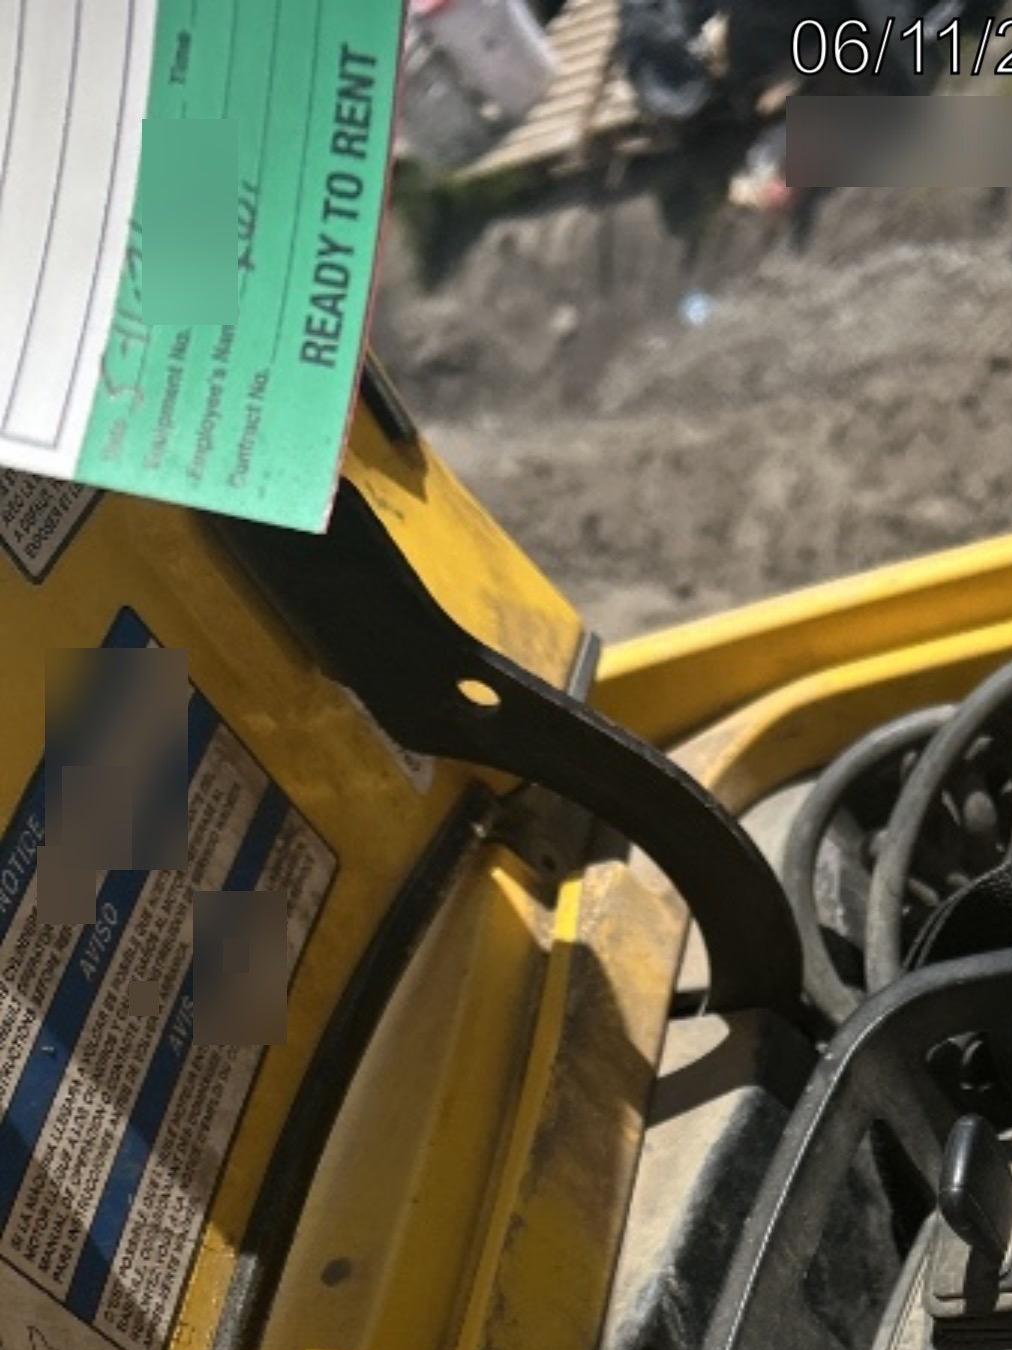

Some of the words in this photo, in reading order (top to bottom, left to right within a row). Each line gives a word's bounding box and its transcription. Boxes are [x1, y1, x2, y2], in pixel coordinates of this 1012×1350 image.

[171, 31, 192, 86] Time
[331, 42, 377, 160] RENT
[322, 172, 363, 226] TO
[300, 234, 352, 369] READY
[78, 902, 119, 980] AVISO
